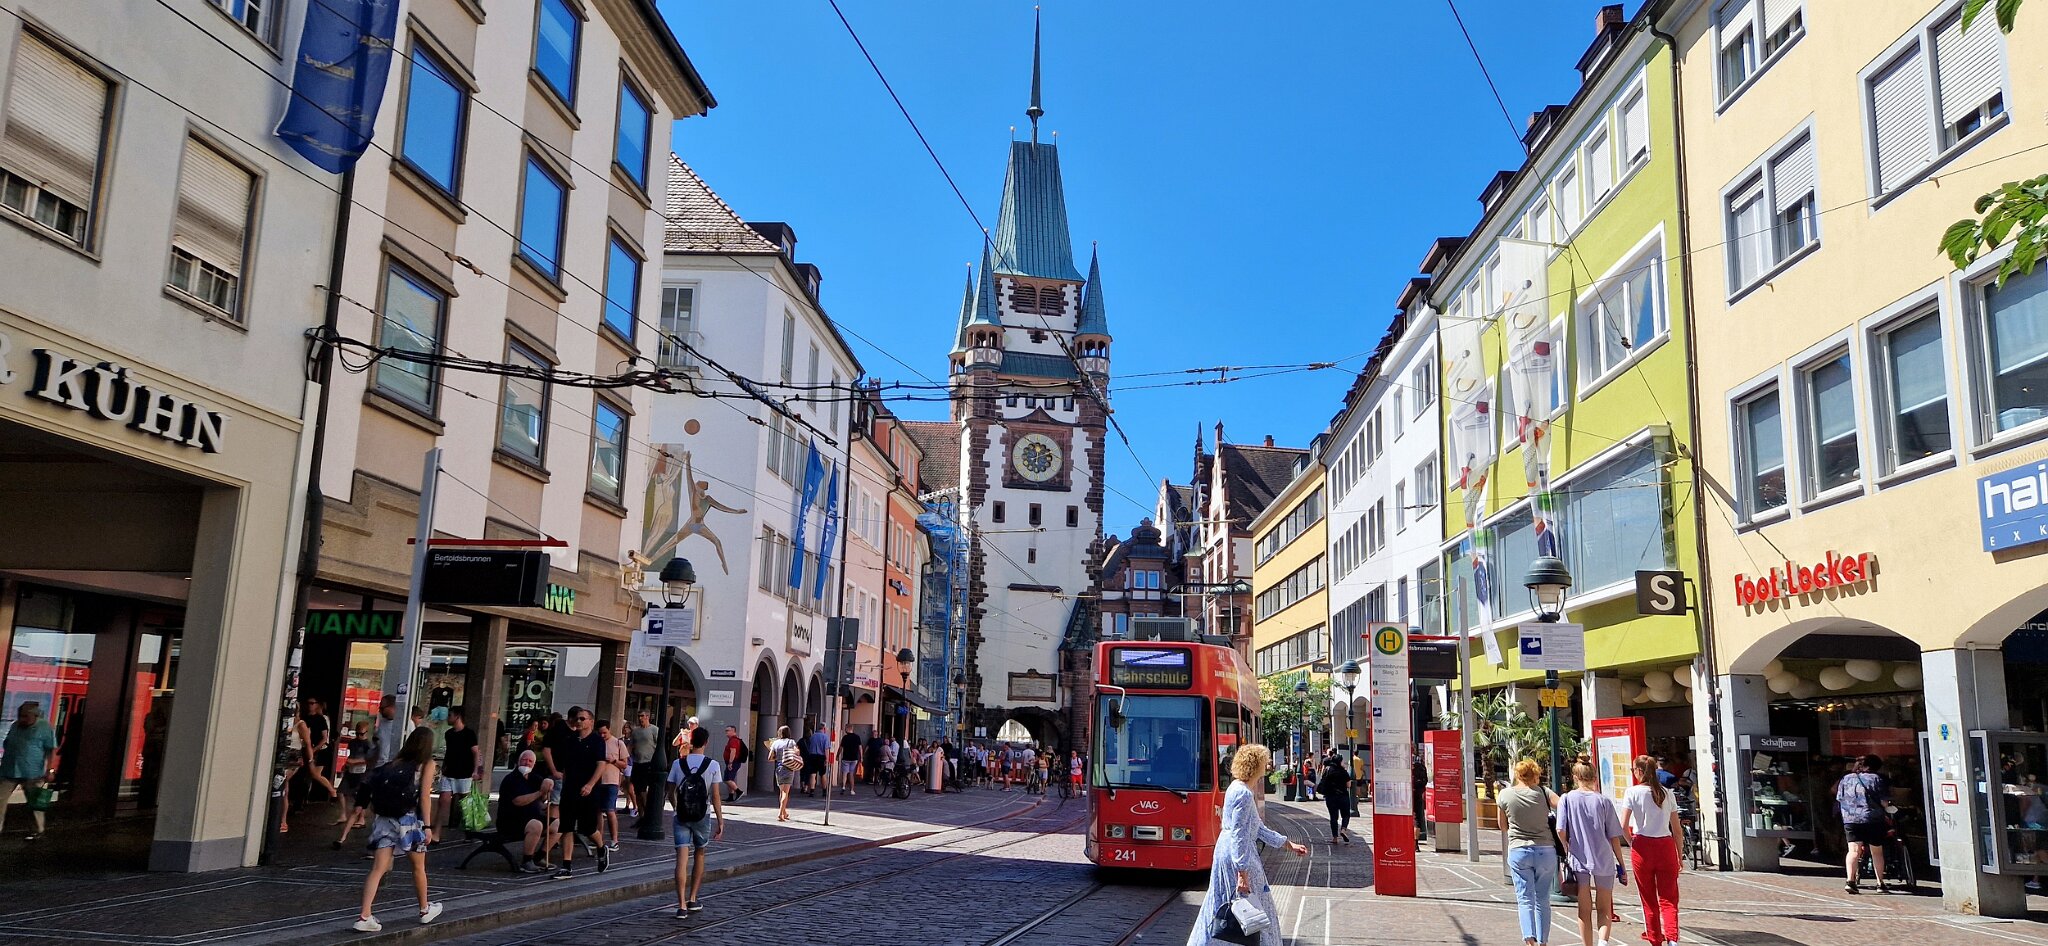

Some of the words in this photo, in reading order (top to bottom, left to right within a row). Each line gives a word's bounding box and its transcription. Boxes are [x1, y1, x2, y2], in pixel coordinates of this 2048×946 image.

[37, 350, 232, 454] KÜHN
[434, 554, 491, 562] Bertoldsbrunnen
[1735, 566, 1781, 606] Foot
[1786, 550, 1873, 595] Locker
[1650, 574, 1675, 611] S
[1383, 633, 1395, 648] H
[1116, 669, 1188, 684] Fahrschule
[1761, 737, 1796, 748] Schafferer
[1140, 800, 1159, 809] VAG
[1115, 849, 1136, 861] 241
